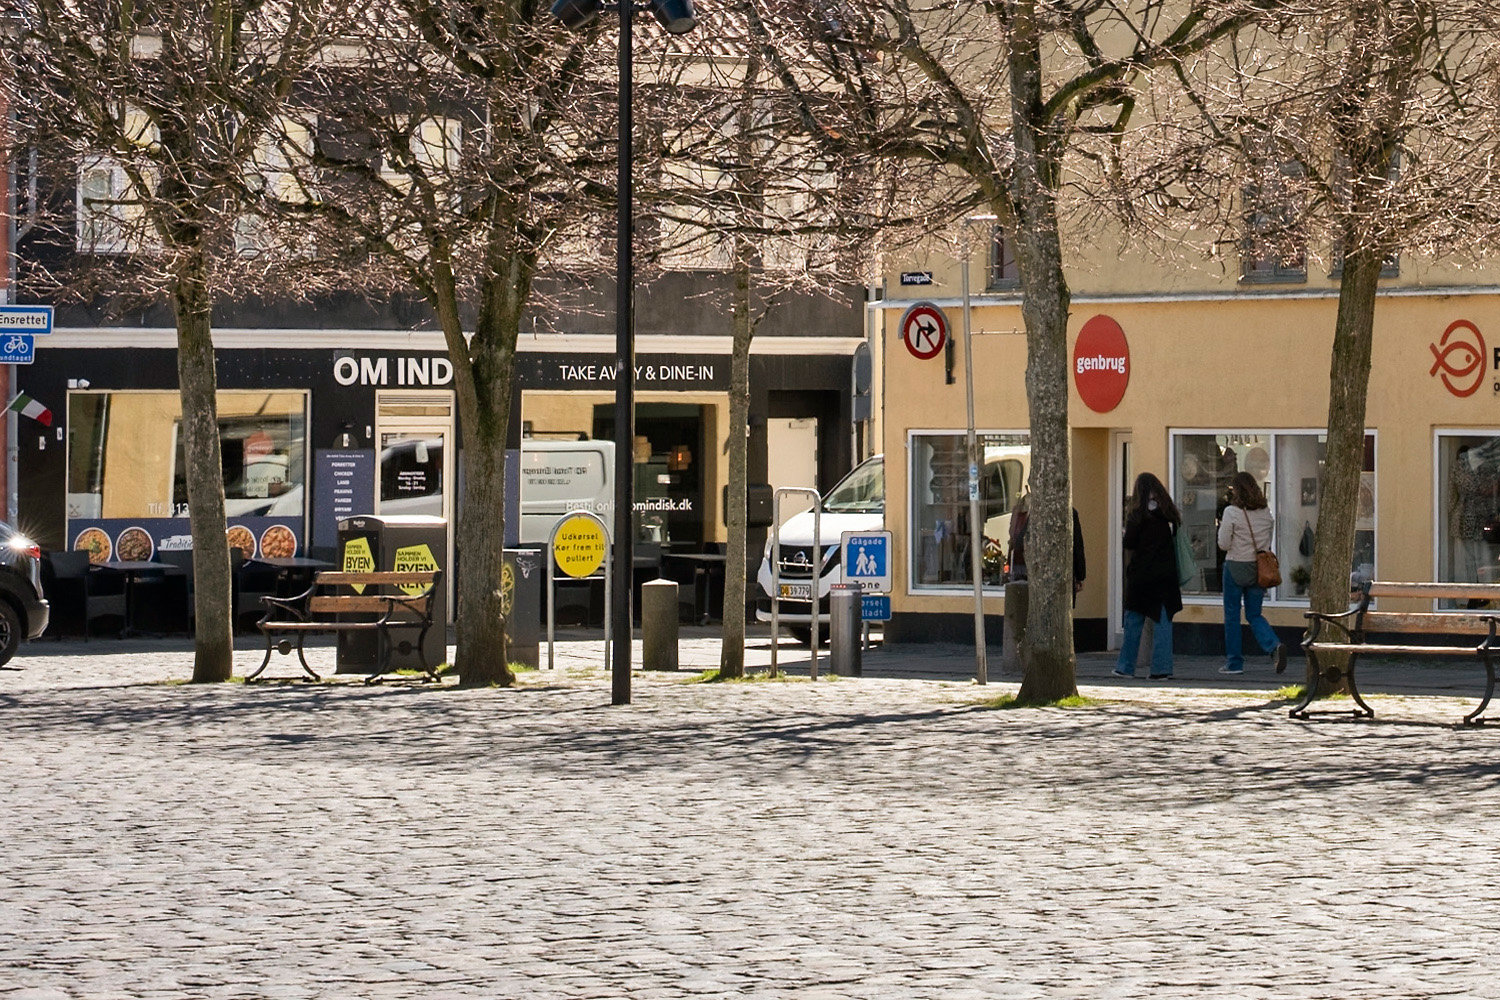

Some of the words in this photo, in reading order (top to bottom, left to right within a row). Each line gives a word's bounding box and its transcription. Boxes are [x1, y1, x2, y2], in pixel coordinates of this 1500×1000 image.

[1077, 354, 1126, 374] genbrug
[334, 357, 387, 385] OM
[398, 357, 453, 385] IND
[559, 365, 597, 380] TAKE
[645, 365, 656, 380] &
[660, 365, 714, 380] DINE-IN
[562, 533, 599, 541] Udkørsel
[851, 537, 882, 546] Gågade
[345, 557, 371, 569] BYEN
[566, 555, 594, 563] pullert
